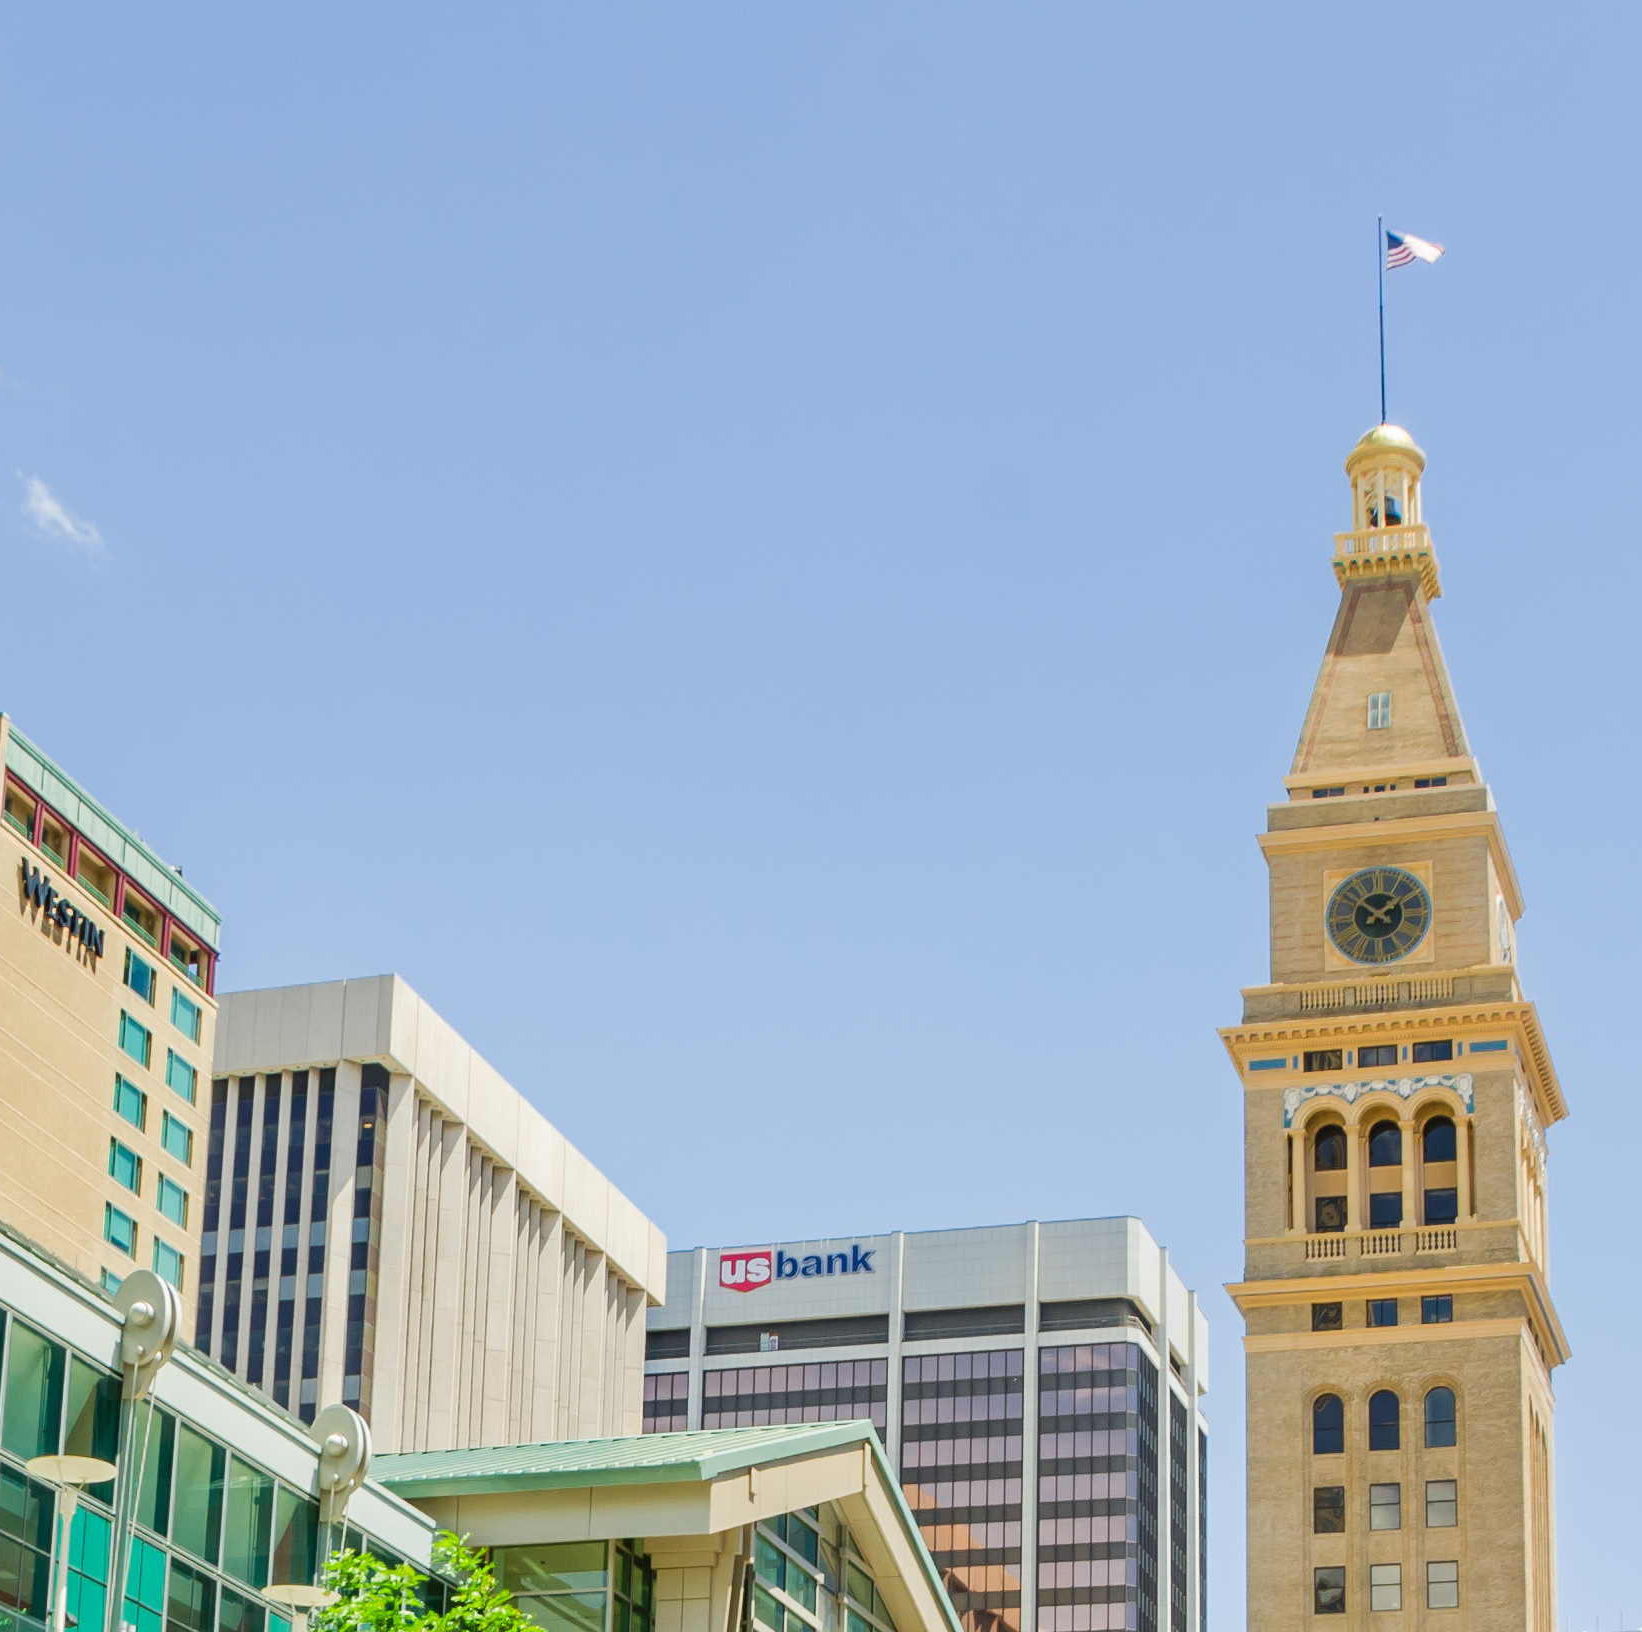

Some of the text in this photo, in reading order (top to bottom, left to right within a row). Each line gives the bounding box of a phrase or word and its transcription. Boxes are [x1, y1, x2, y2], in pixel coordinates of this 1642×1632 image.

[21, 856, 106, 959] WESTIN
[720, 1245, 876, 1286] us bank
